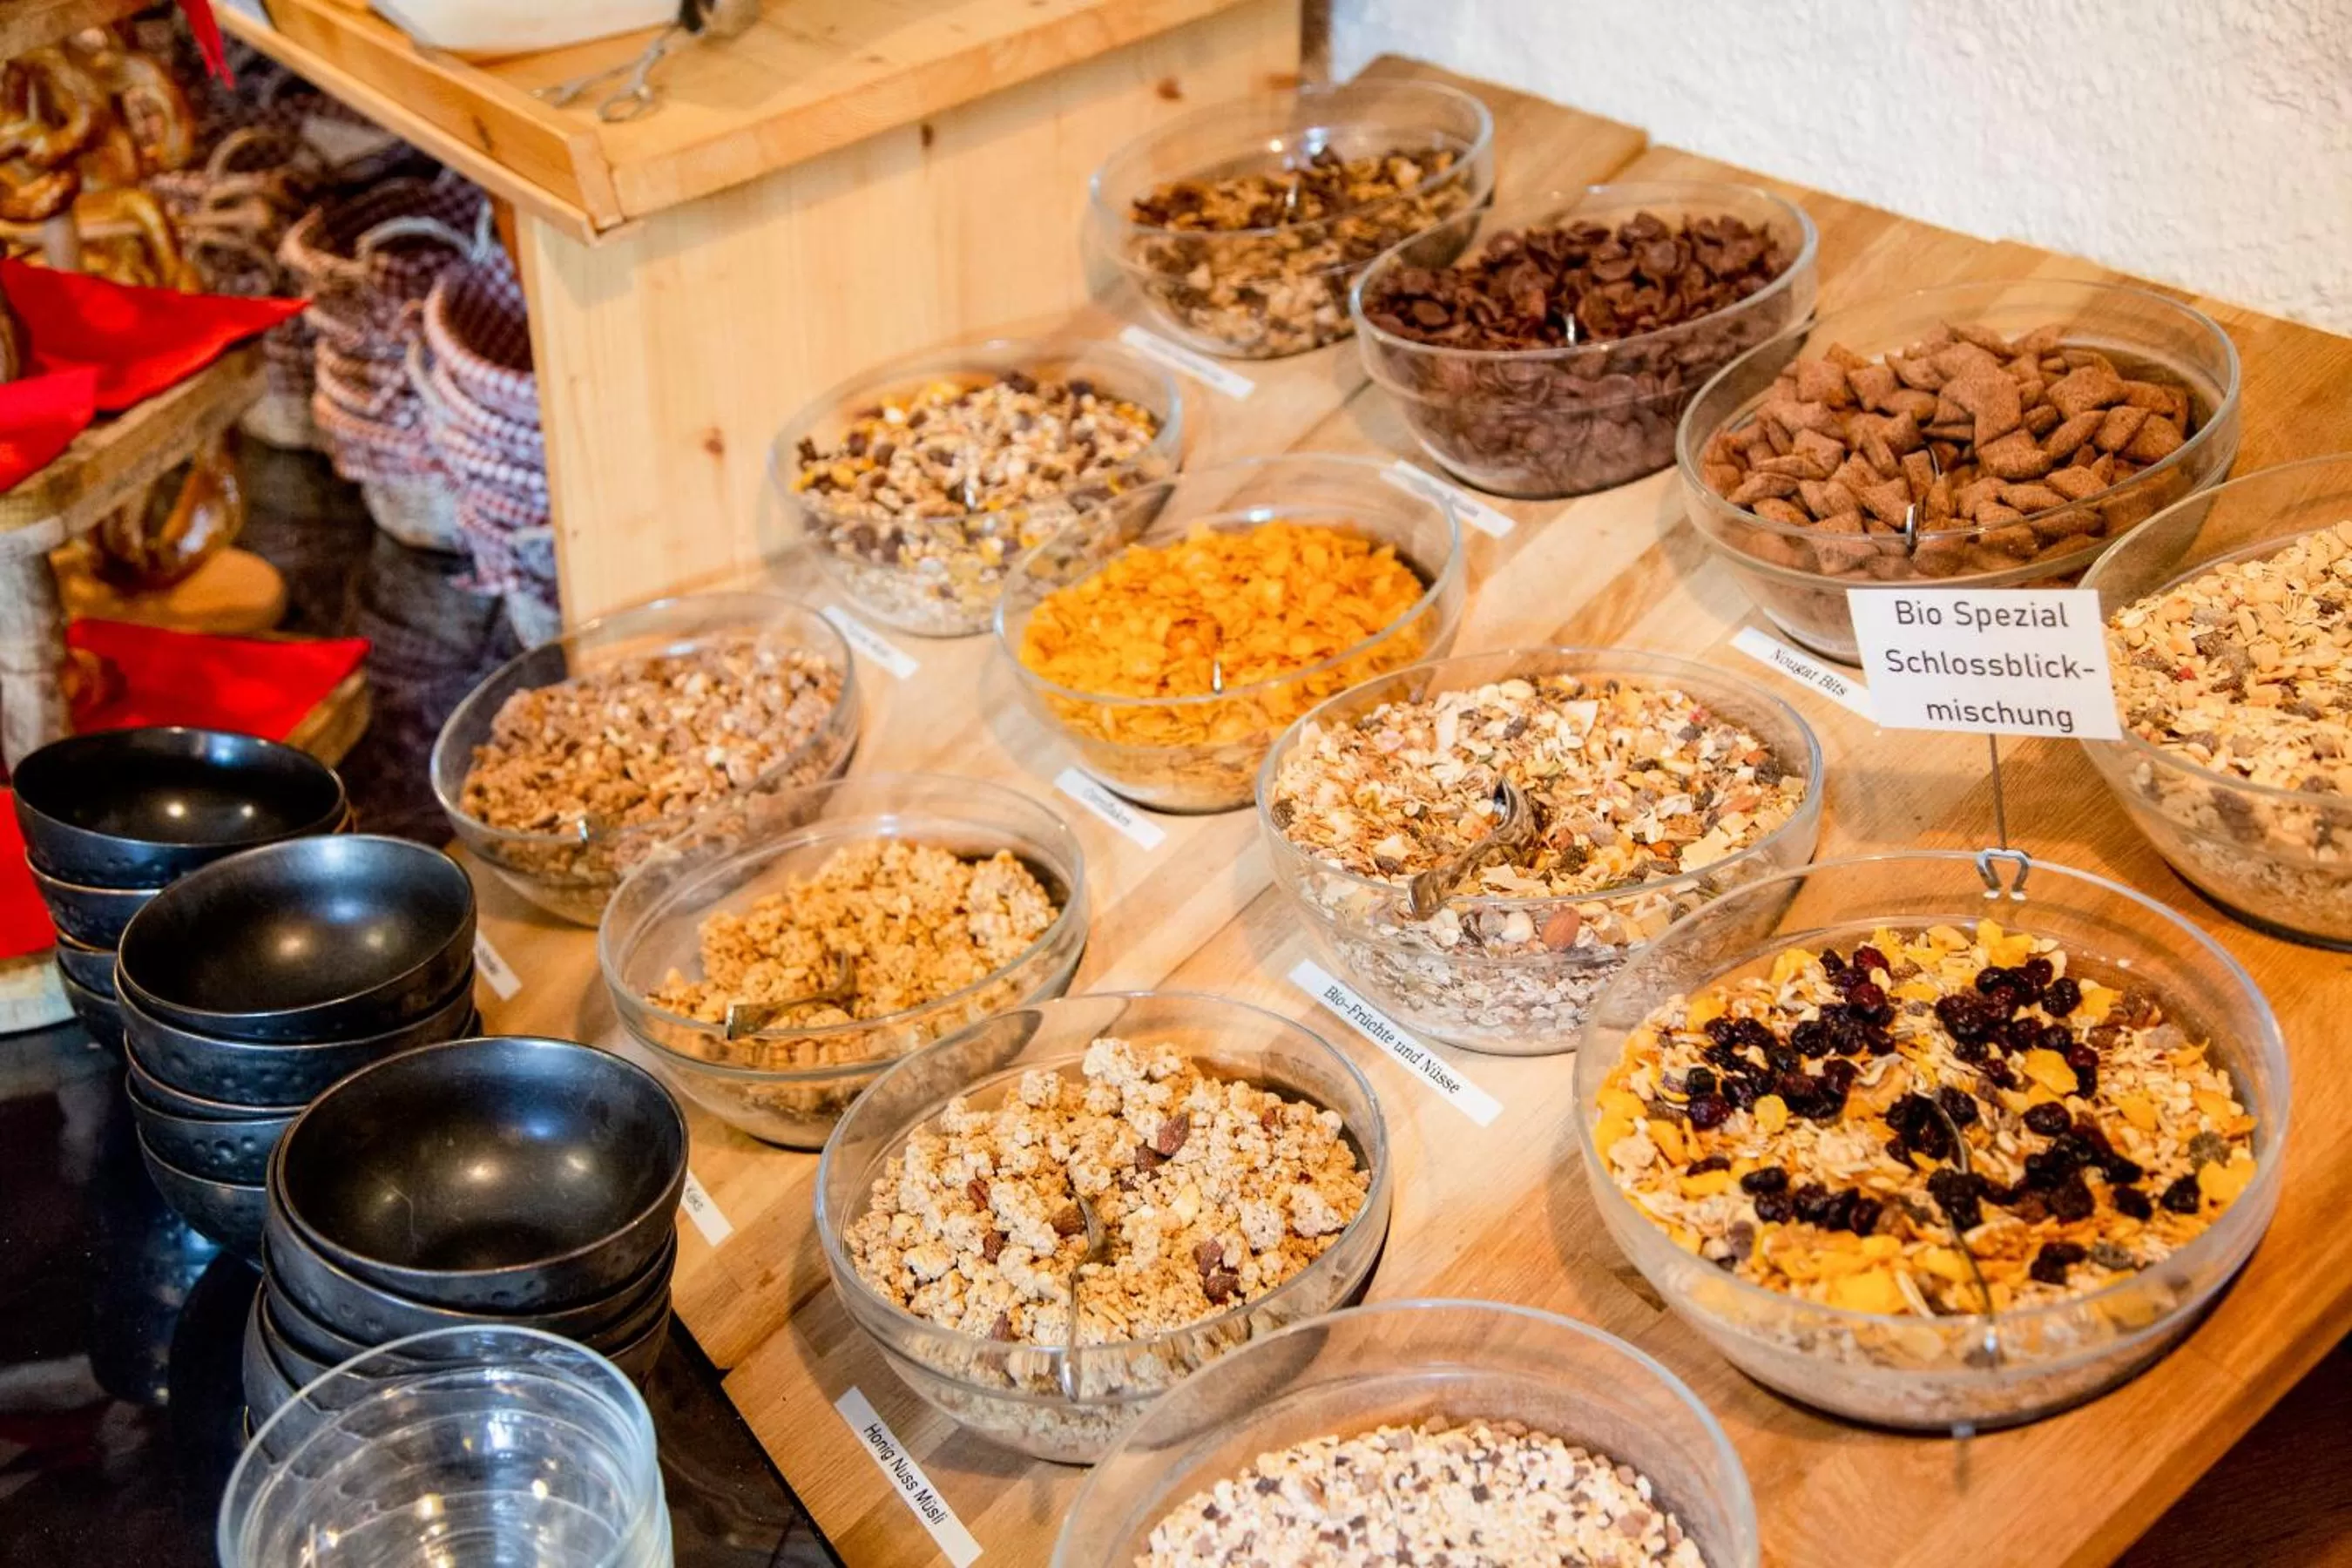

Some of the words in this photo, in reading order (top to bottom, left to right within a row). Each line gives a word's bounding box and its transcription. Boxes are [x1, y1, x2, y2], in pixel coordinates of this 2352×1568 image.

[1895, 599, 1943, 625] Bio
[1953, 601, 2070, 633] Spezial
[1884, 648, 2096, 680] Schlossblick-
[1925, 699, 2074, 734] mischung
[1323, 984, 1395, 1044] Bio-Früchte
[1393, 1040, 1423, 1065] und
[1419, 1058, 1461, 1095] Nüsse
[863, 1423, 896, 1462] Honig
[890, 1457, 919, 1491] Nuss
[913, 1488, 949, 1525] Müsli
